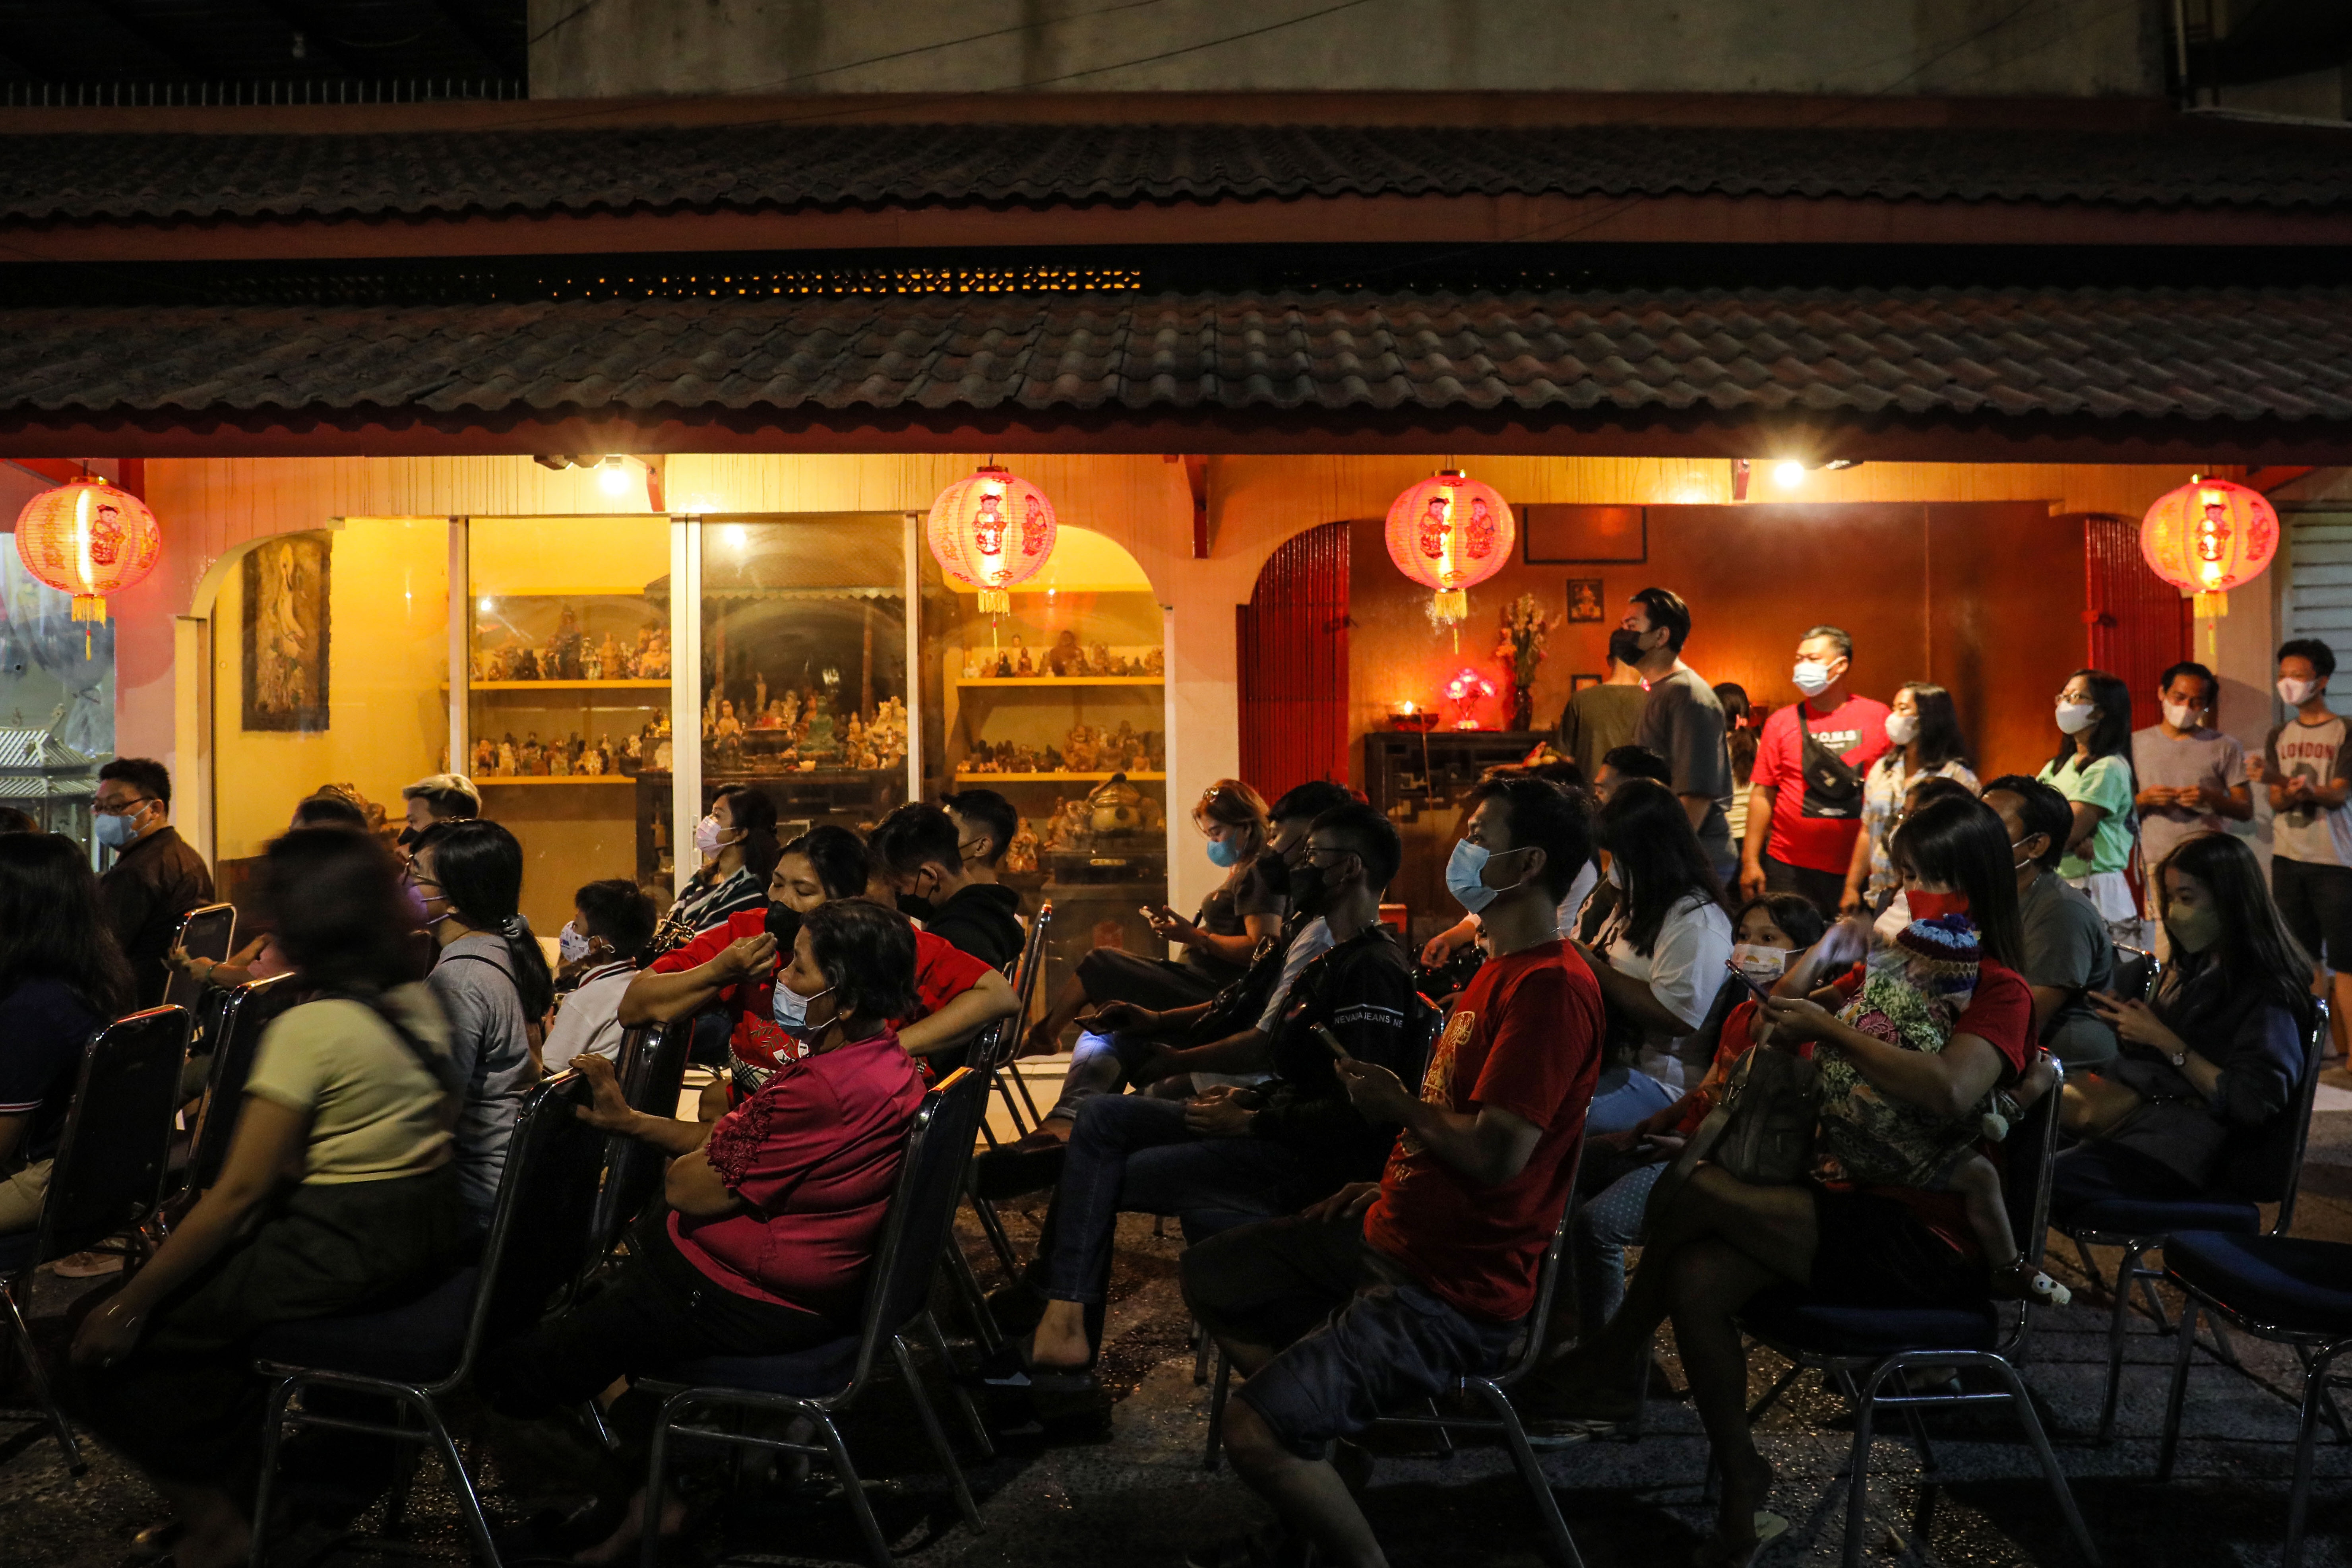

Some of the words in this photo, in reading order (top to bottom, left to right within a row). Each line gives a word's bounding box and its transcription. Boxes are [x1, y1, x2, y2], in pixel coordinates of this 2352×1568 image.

[2281, 742, 2335, 760] LONDON
[1334, 1011, 1363, 1024] NEVADA
[1364, 1012, 1390, 1023] JEANS
